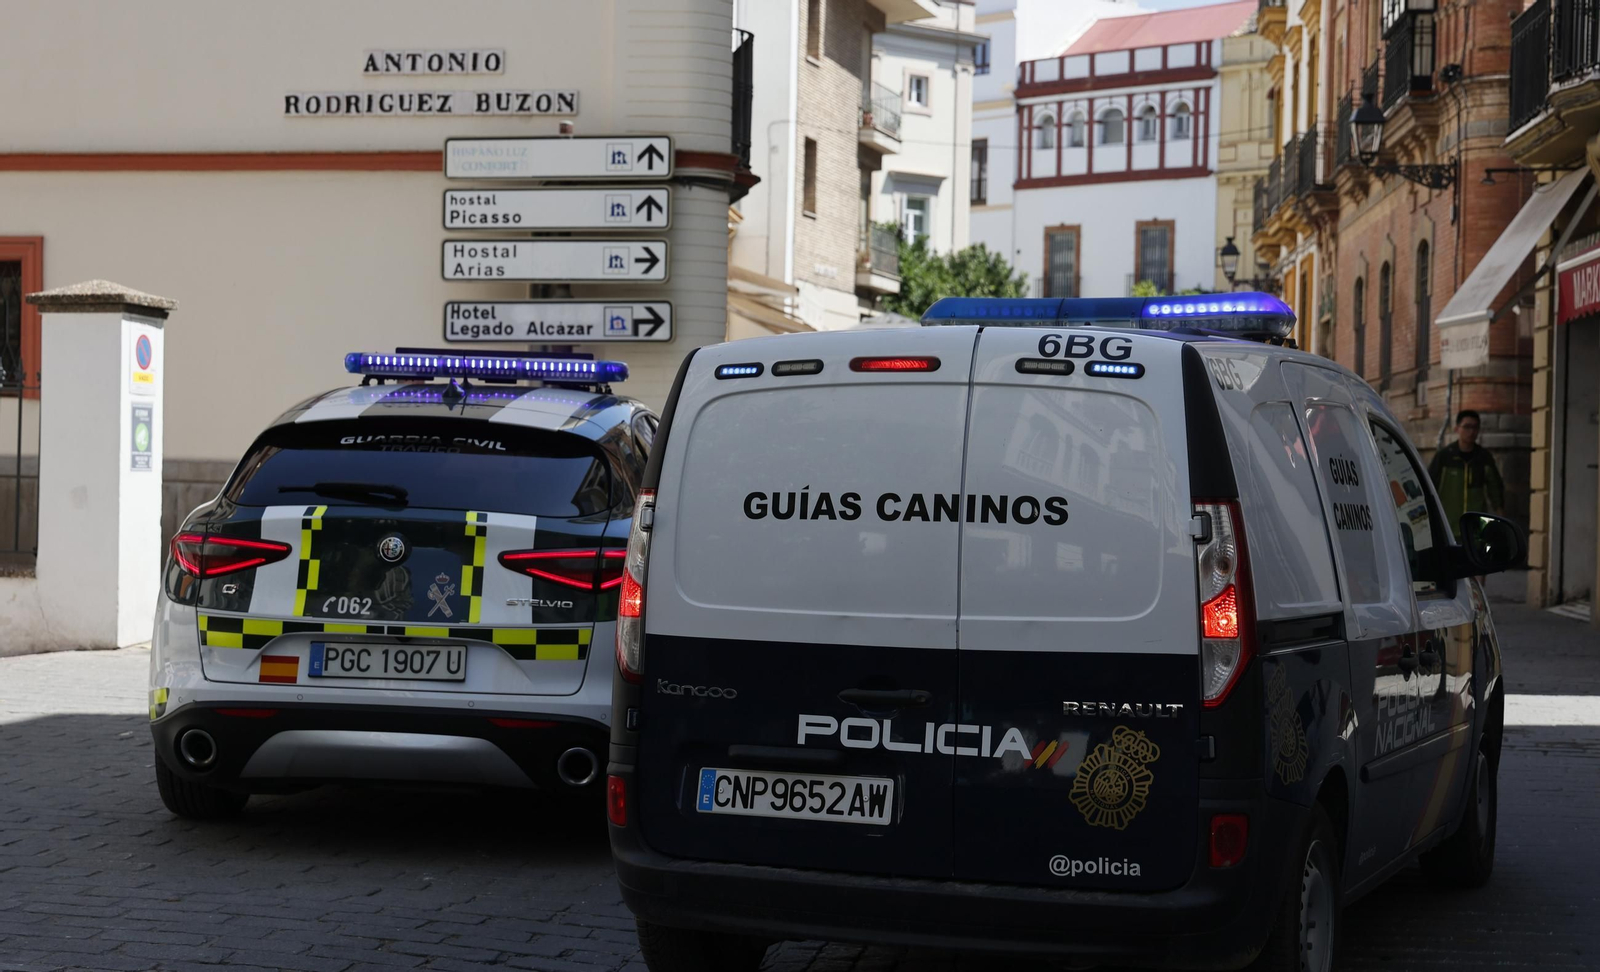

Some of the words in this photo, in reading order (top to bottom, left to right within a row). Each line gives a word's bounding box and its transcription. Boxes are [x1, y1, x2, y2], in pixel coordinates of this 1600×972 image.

[363, 51, 502, 73] ANTONIO
[284, 92, 453, 115] RODRIGUEZ
[475, 91, 576, 113] BUZON
[450, 194, 497, 206] hostal
[450, 210, 522, 224] Picasso
[453, 244, 517, 258] Hostal
[453, 262, 505, 277] Arias
[1573, 263, 1600, 310] MARK
[450, 305, 497, 320] Hotel
[450, 321, 514, 338] Legado
[1038, 333, 1133, 361] 6BG
[1209, 358, 1244, 391] 6BG
[339, 435, 442, 445] GUARDIA
[453, 437, 506, 451] CIVIL
[1329, 453, 1359, 487] GUÍAS
[743, 485, 862, 521] GUÍAS
[876, 491, 1070, 527] CANINOS
[1333, 502, 1374, 531] CANINOS
[337, 596, 372, 615] 062
[506, 598, 574, 609] STELVIO
[324, 647, 372, 673] PGC
[382, 648, 441, 675] 1907
[446, 650, 462, 675] U
[656, 678, 738, 700] Kangoo
[1063, 700, 1183, 719] RENAULT
[797, 714, 1032, 761] POLICIA
[702, 794, 710, 804] E
[1049, 853, 1142, 878] @policia
